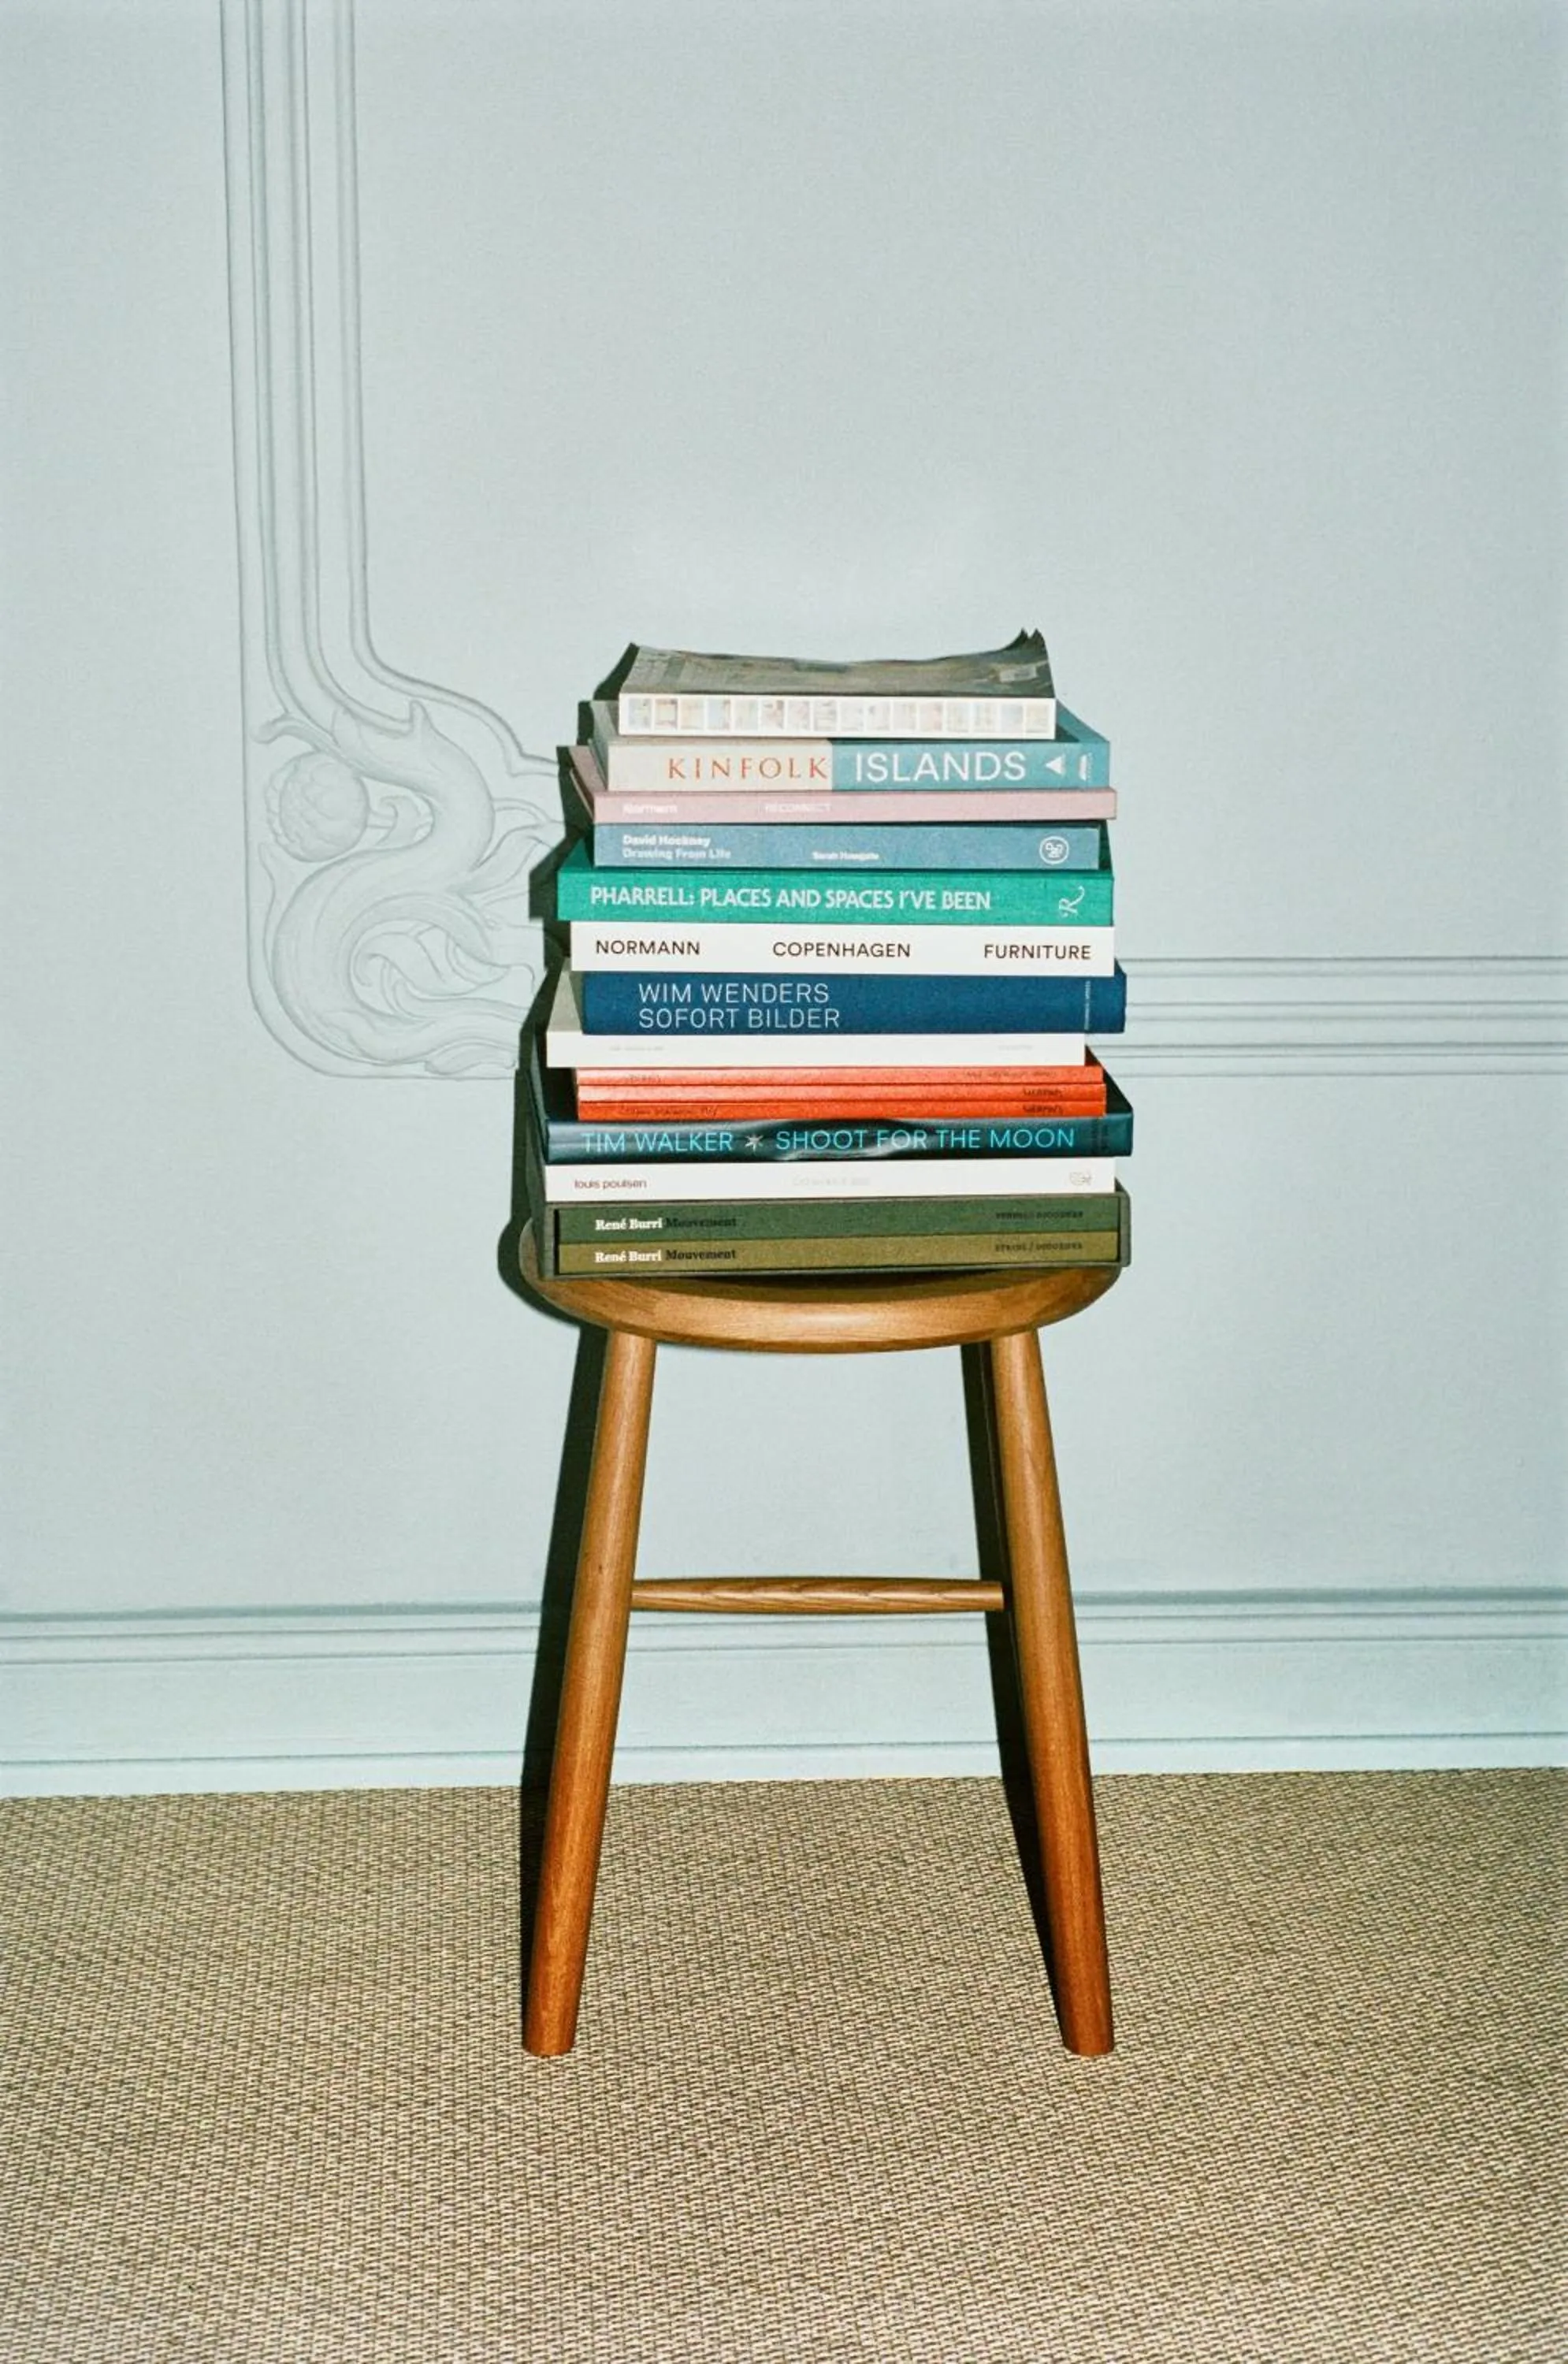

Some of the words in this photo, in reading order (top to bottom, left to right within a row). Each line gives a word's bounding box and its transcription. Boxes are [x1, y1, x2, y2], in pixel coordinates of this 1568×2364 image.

[668, 756, 828, 779] KINFOLK
[856, 750, 1026, 782] ISLANDS
[622, 834, 656, 846] David
[659, 835, 711, 847] Hockney
[622, 846, 672, 860] Drawing
[674, 847, 708, 858] From
[709, 848, 731, 859] Life
[590, 886, 695, 906] PHARRELL:
[700, 887, 771, 908] PLACES
[776, 888, 821, 909] AND
[826, 889, 894, 910] SPACES
[898, 890, 937, 910] I'VE
[941, 890, 991, 911] BEEN
[596, 939, 700, 956] NORMANN
[772, 941, 911, 958] COPENHAGEN
[983, 943, 1091, 961] FURNITURE
[638, 983, 692, 1004] WIM
[700, 983, 829, 1005] WENDERS
[638, 1007, 740, 1029] SOFORT
[748, 1008, 840, 1029] BILDER
[581, 1132, 626, 1153] TIM
[634, 1132, 734, 1152] WALKER
[775, 1129, 868, 1150] SHOOT
[876, 1129, 927, 1150] FOR
[935, 1128, 980, 1149] THE
[990, 1128, 1076, 1149] MOON
[595, 1217, 626, 1231] René
[627, 1217, 663, 1229] Burri
[594, 1249, 626, 1263] René
[627, 1248, 663, 1262] Burri
[666, 1249, 737, 1261] Mouvement
